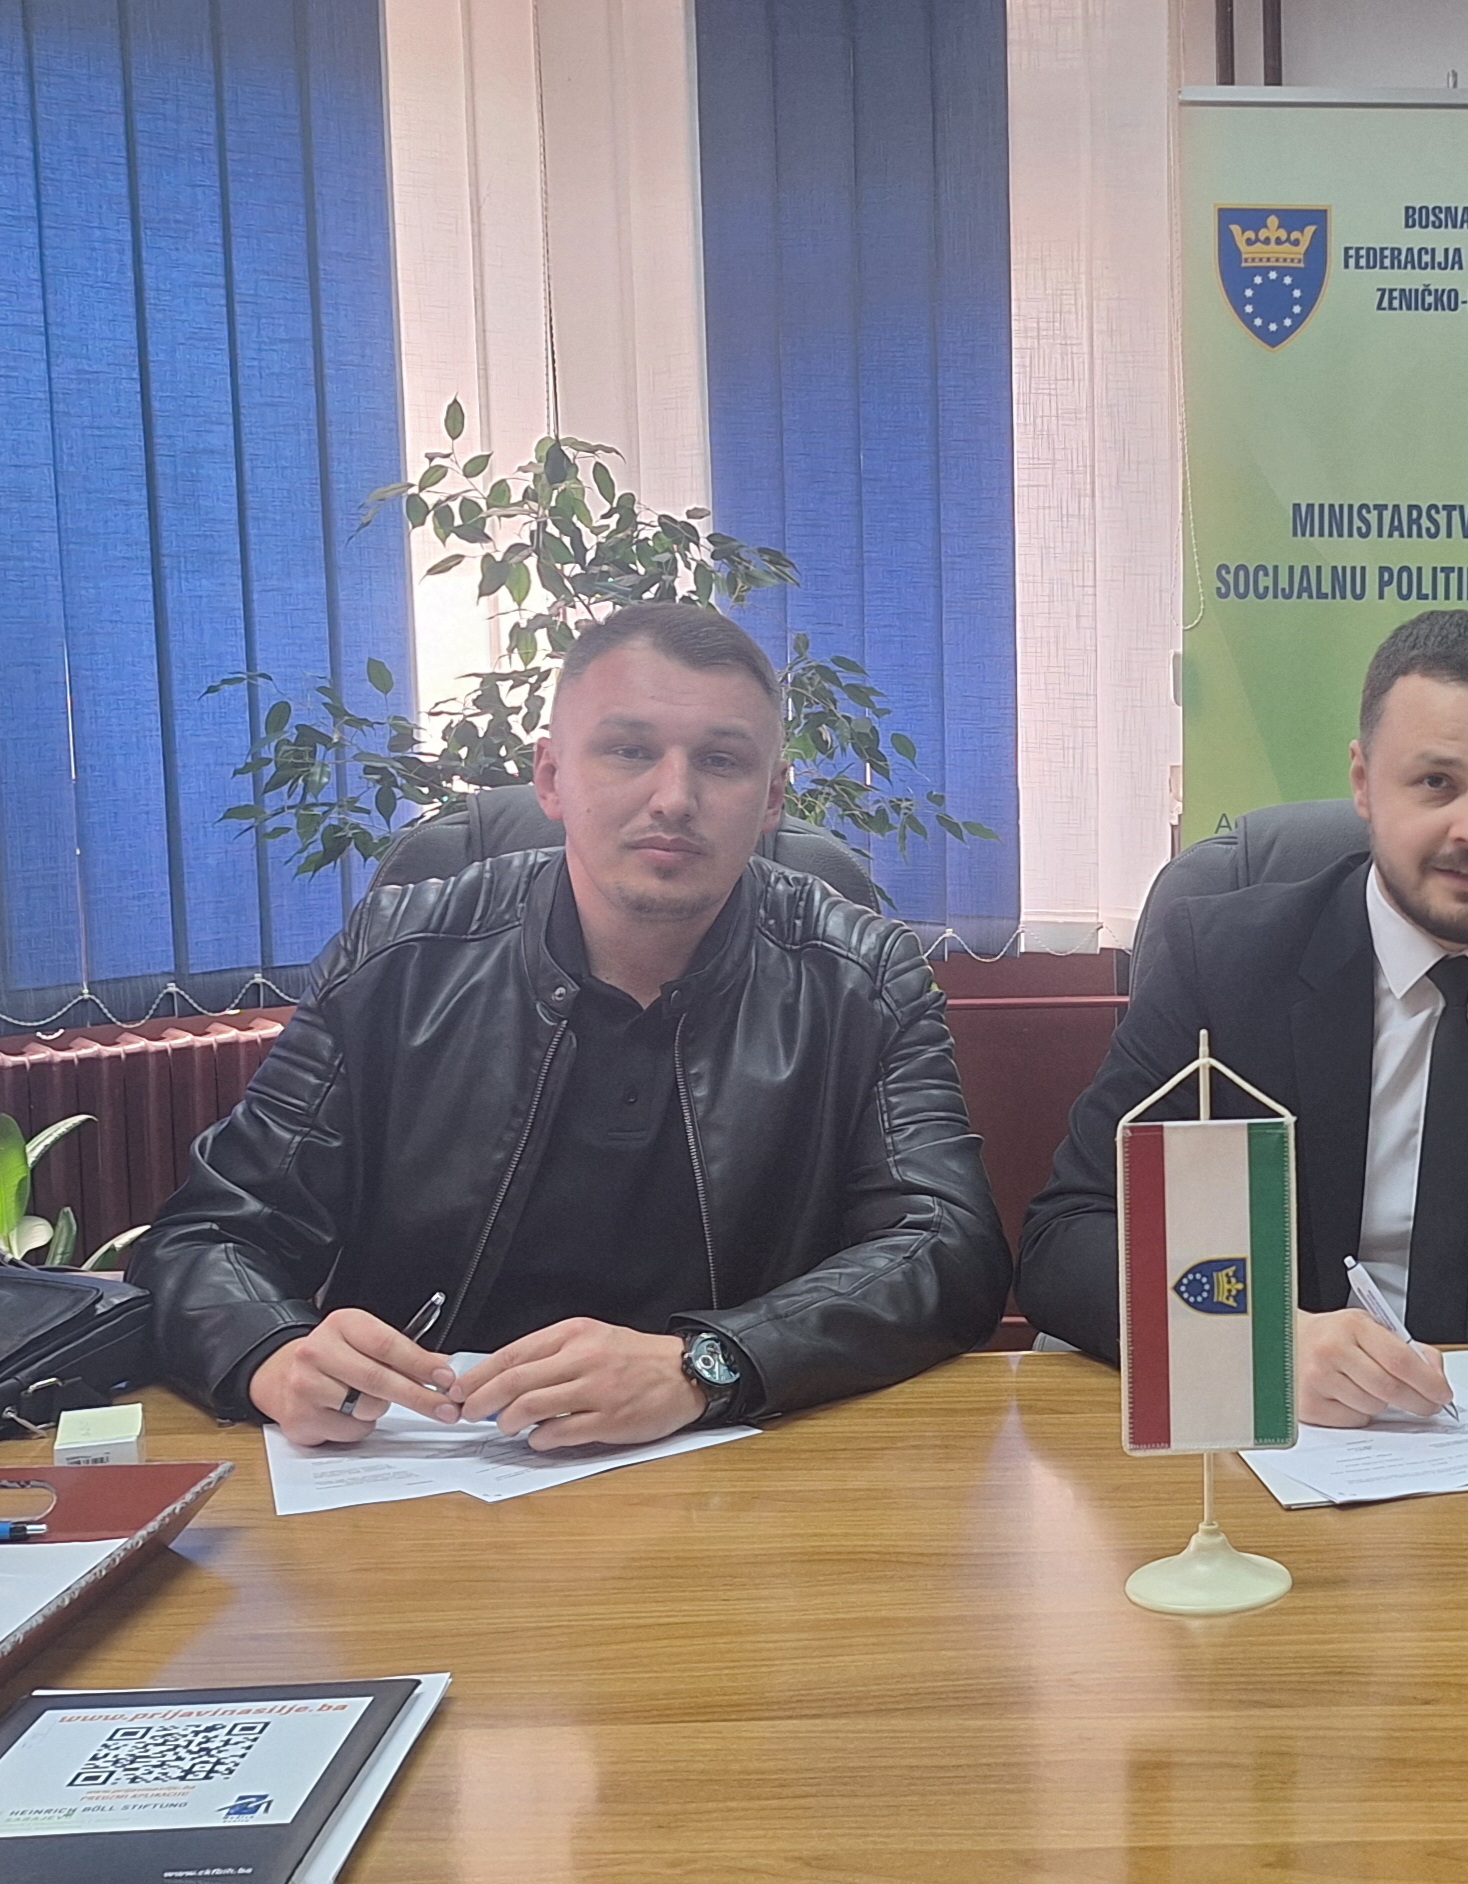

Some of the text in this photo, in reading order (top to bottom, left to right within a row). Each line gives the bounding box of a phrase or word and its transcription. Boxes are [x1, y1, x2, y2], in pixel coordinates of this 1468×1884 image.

[1343, 246, 1464, 271] FEDERACIJA
[1216, 563, 1367, 602] SOCIJALNU
[58, 1703, 349, 1723] www.prijavinasilje.ba
[9, 1806, 78, 1817] HEINRICH
[121, 1801, 188, 1811] STIFTUNG
